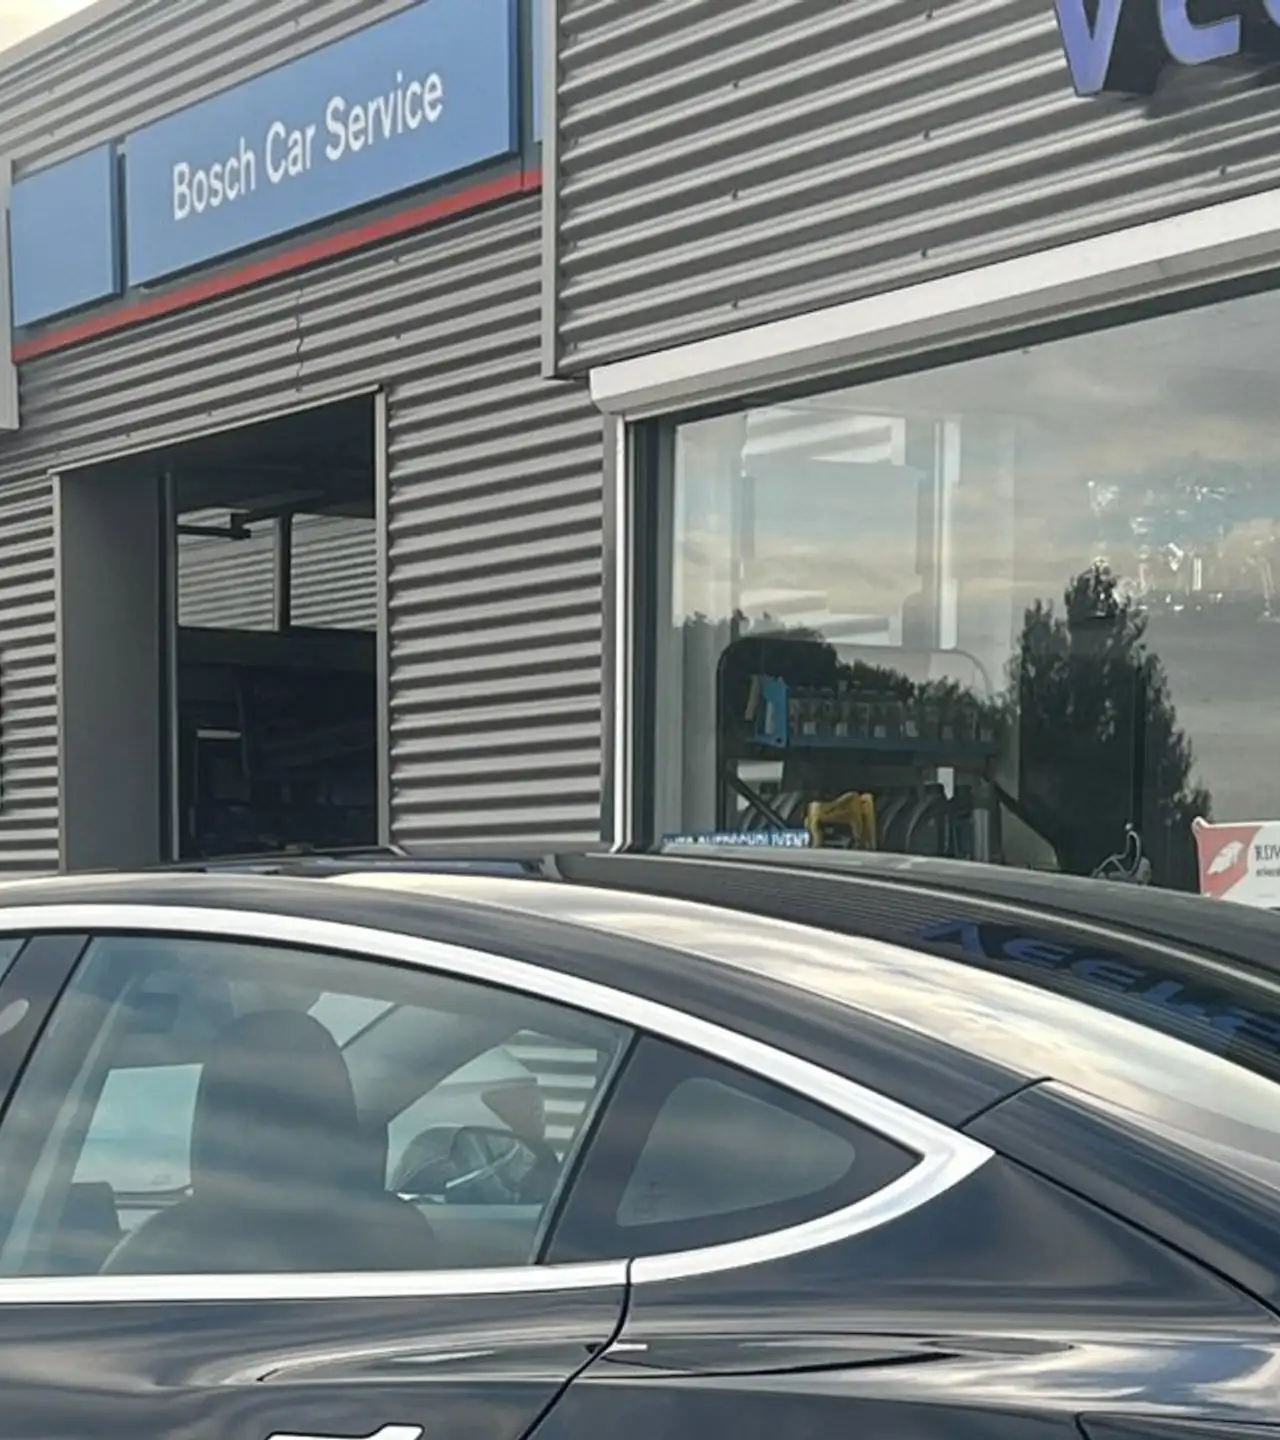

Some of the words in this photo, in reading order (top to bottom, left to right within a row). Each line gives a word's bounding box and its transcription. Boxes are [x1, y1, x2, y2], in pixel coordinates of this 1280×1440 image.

[173, 136, 256, 221] Bosch
[265, 120, 316, 184] Car
[325, 70, 443, 161] Service
